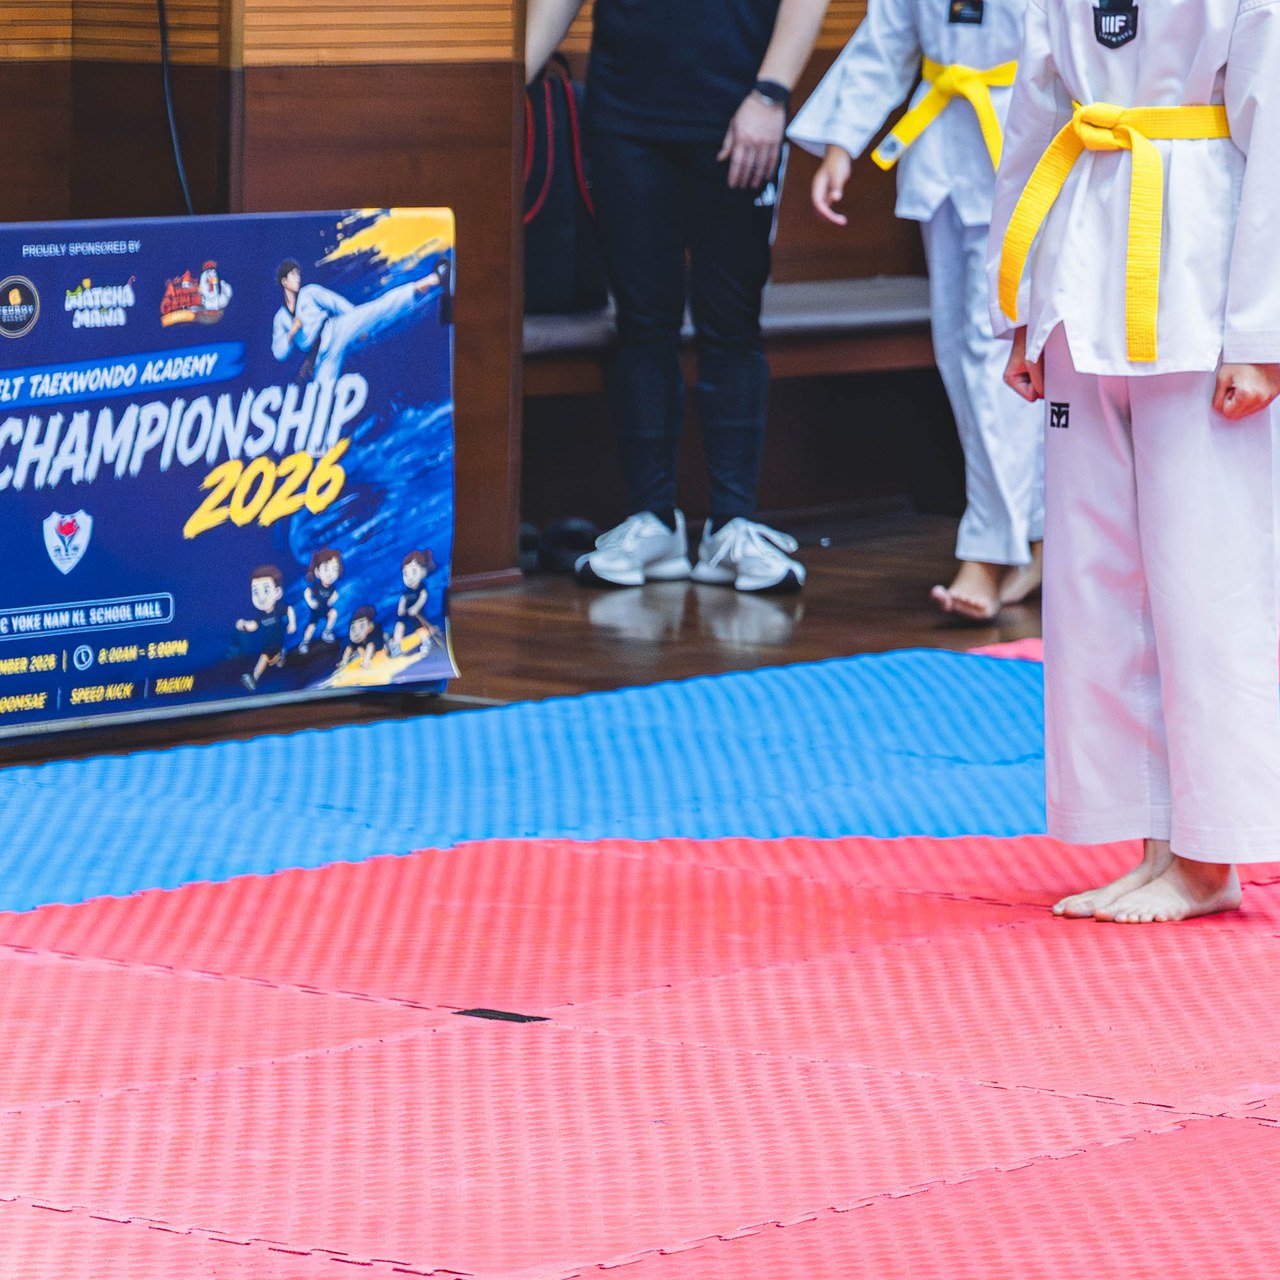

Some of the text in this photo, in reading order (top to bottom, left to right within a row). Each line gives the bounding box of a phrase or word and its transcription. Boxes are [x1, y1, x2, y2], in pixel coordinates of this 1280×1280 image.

[29, 362, 137, 398] TAEKWONDO
[140, 352, 218, 385] ACADEMY
[0, 372, 369, 491] CHAMPIONSHIP
[183, 438, 350, 539] 2026
[12, 612, 42, 633] YOKE
[43, 610, 70, 629] NAM
[89, 604, 133, 624] SCHOOL
[134, 601, 163, 620] HALL
